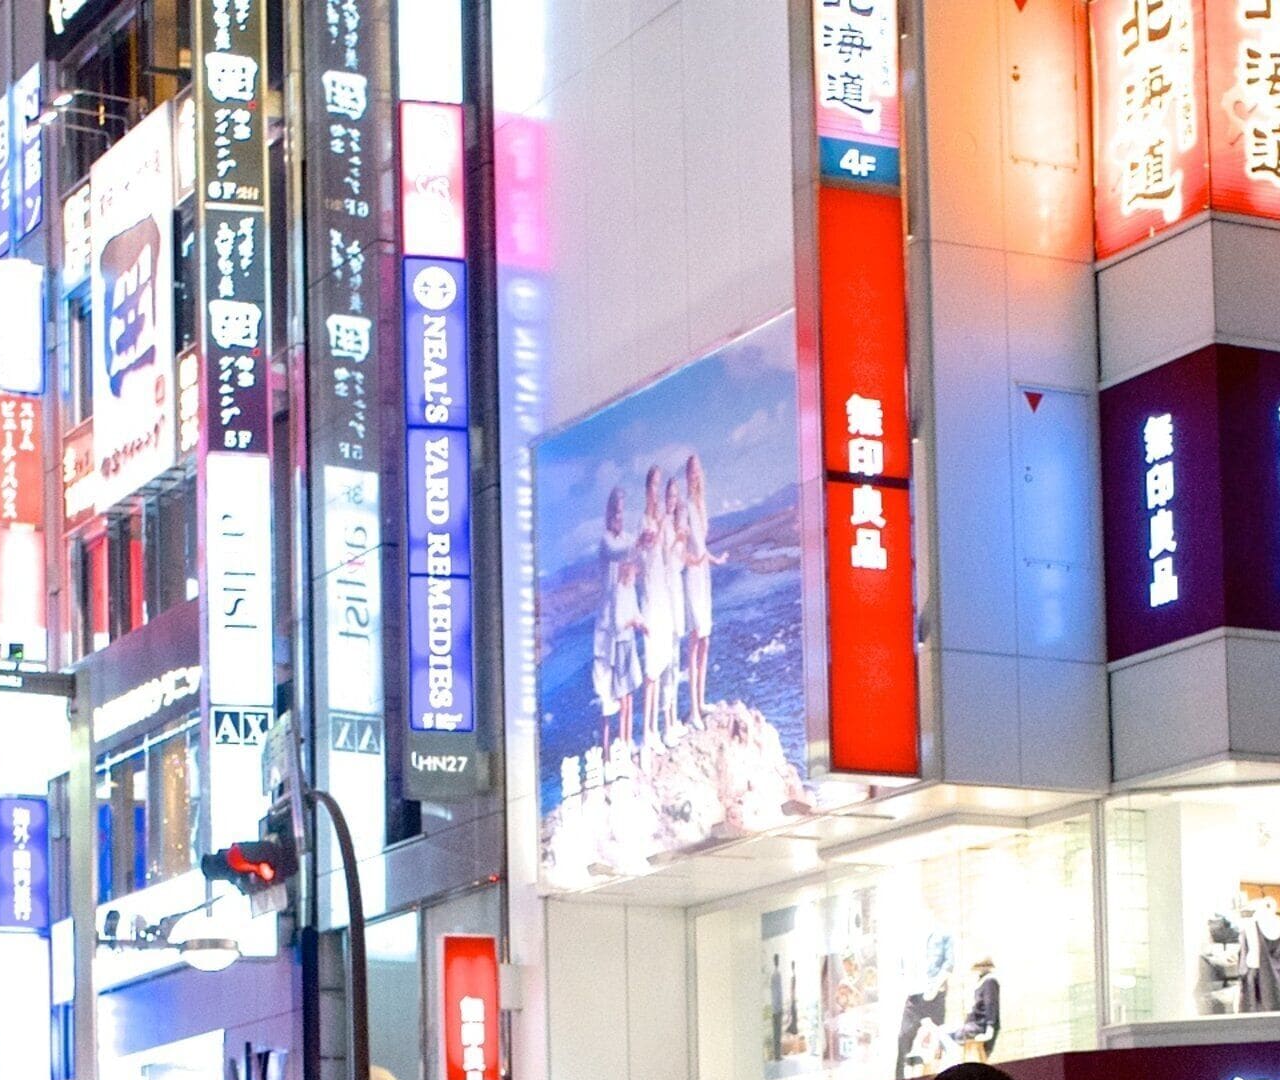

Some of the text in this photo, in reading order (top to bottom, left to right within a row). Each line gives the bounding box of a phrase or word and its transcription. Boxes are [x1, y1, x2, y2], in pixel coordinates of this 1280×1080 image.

[840, 149, 876, 177] 4F
[424, 315, 452, 708] NEAL'S YARD REMEDIES
[847, 394, 887, 570] 無印良品
[1144, 414, 1178, 607] 無印良品
